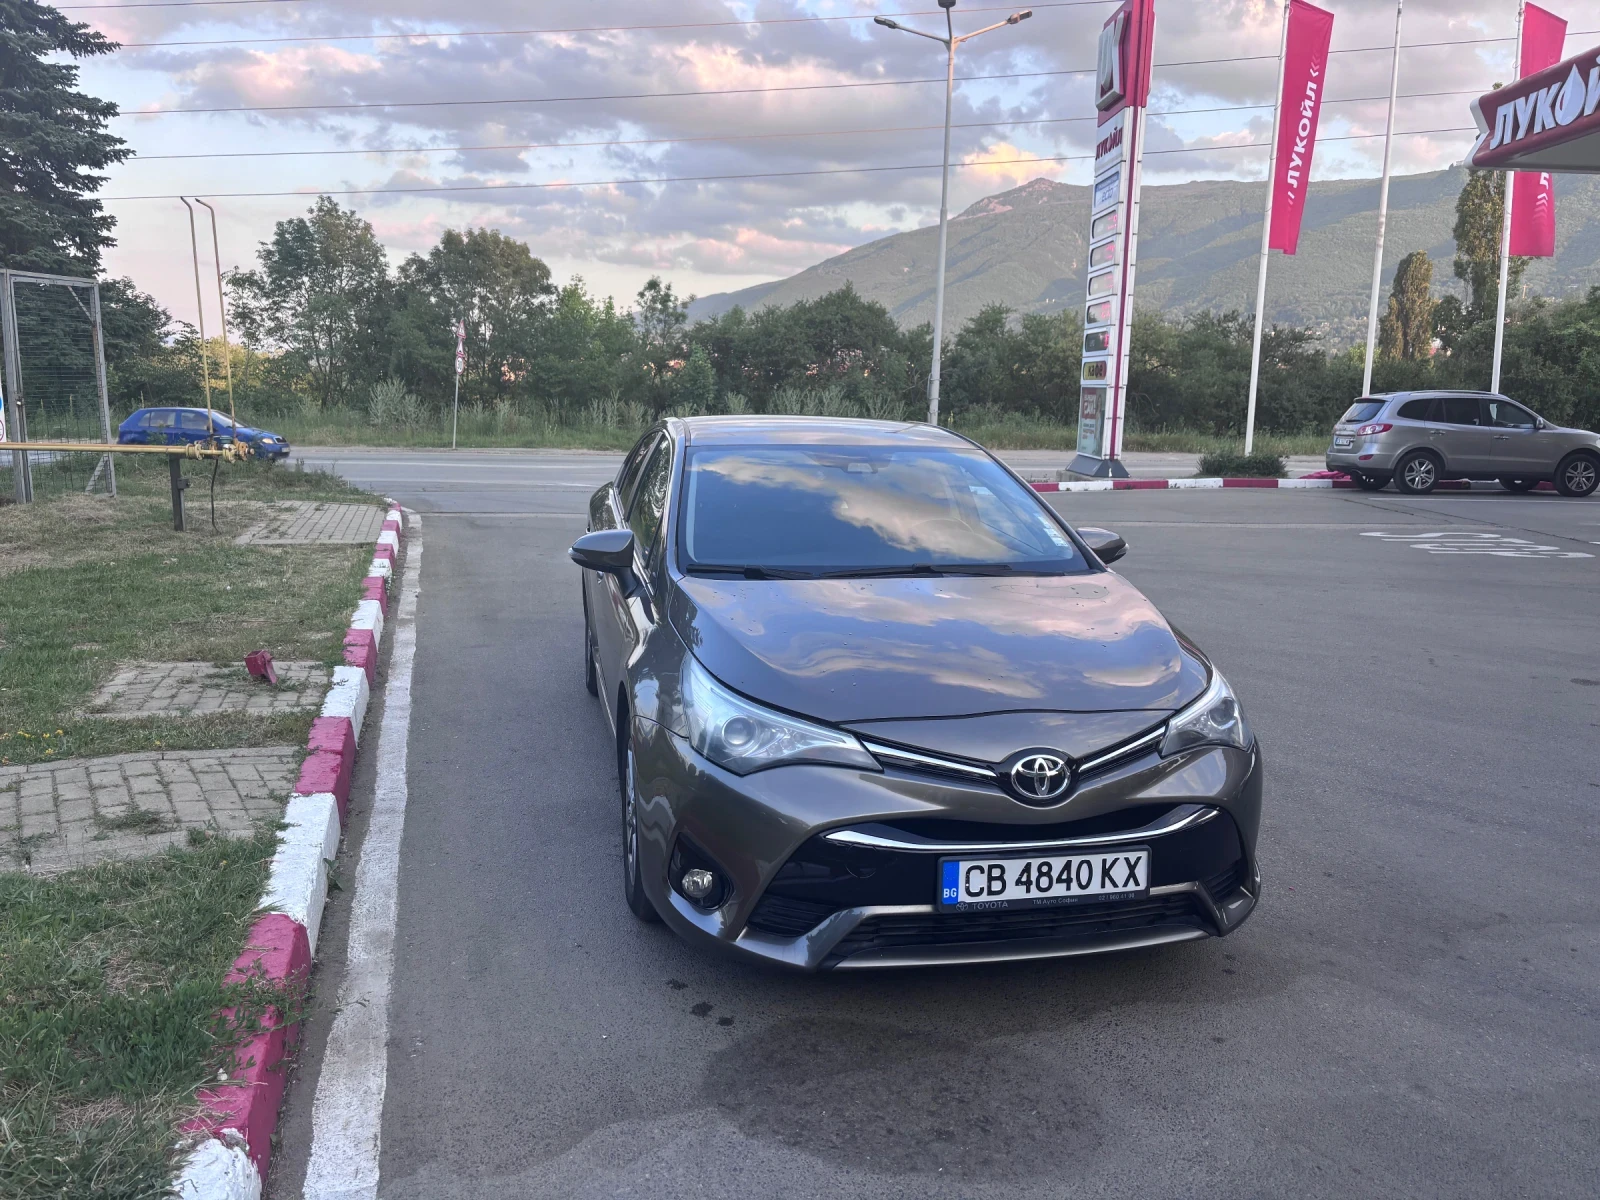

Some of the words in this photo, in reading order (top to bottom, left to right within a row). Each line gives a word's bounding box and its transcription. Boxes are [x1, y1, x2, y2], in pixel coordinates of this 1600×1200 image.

[1286, 81, 1318, 188] ЛУКОЙЛ
[1359, 531, 1595, 558] STOP
[965, 863, 1007, 897] CB
[1015, 859, 1093, 894] 4840
[1100, 856, 1142, 889] KX
[943, 888, 957, 898] BG
[972, 901, 1009, 910] TOYOTA
